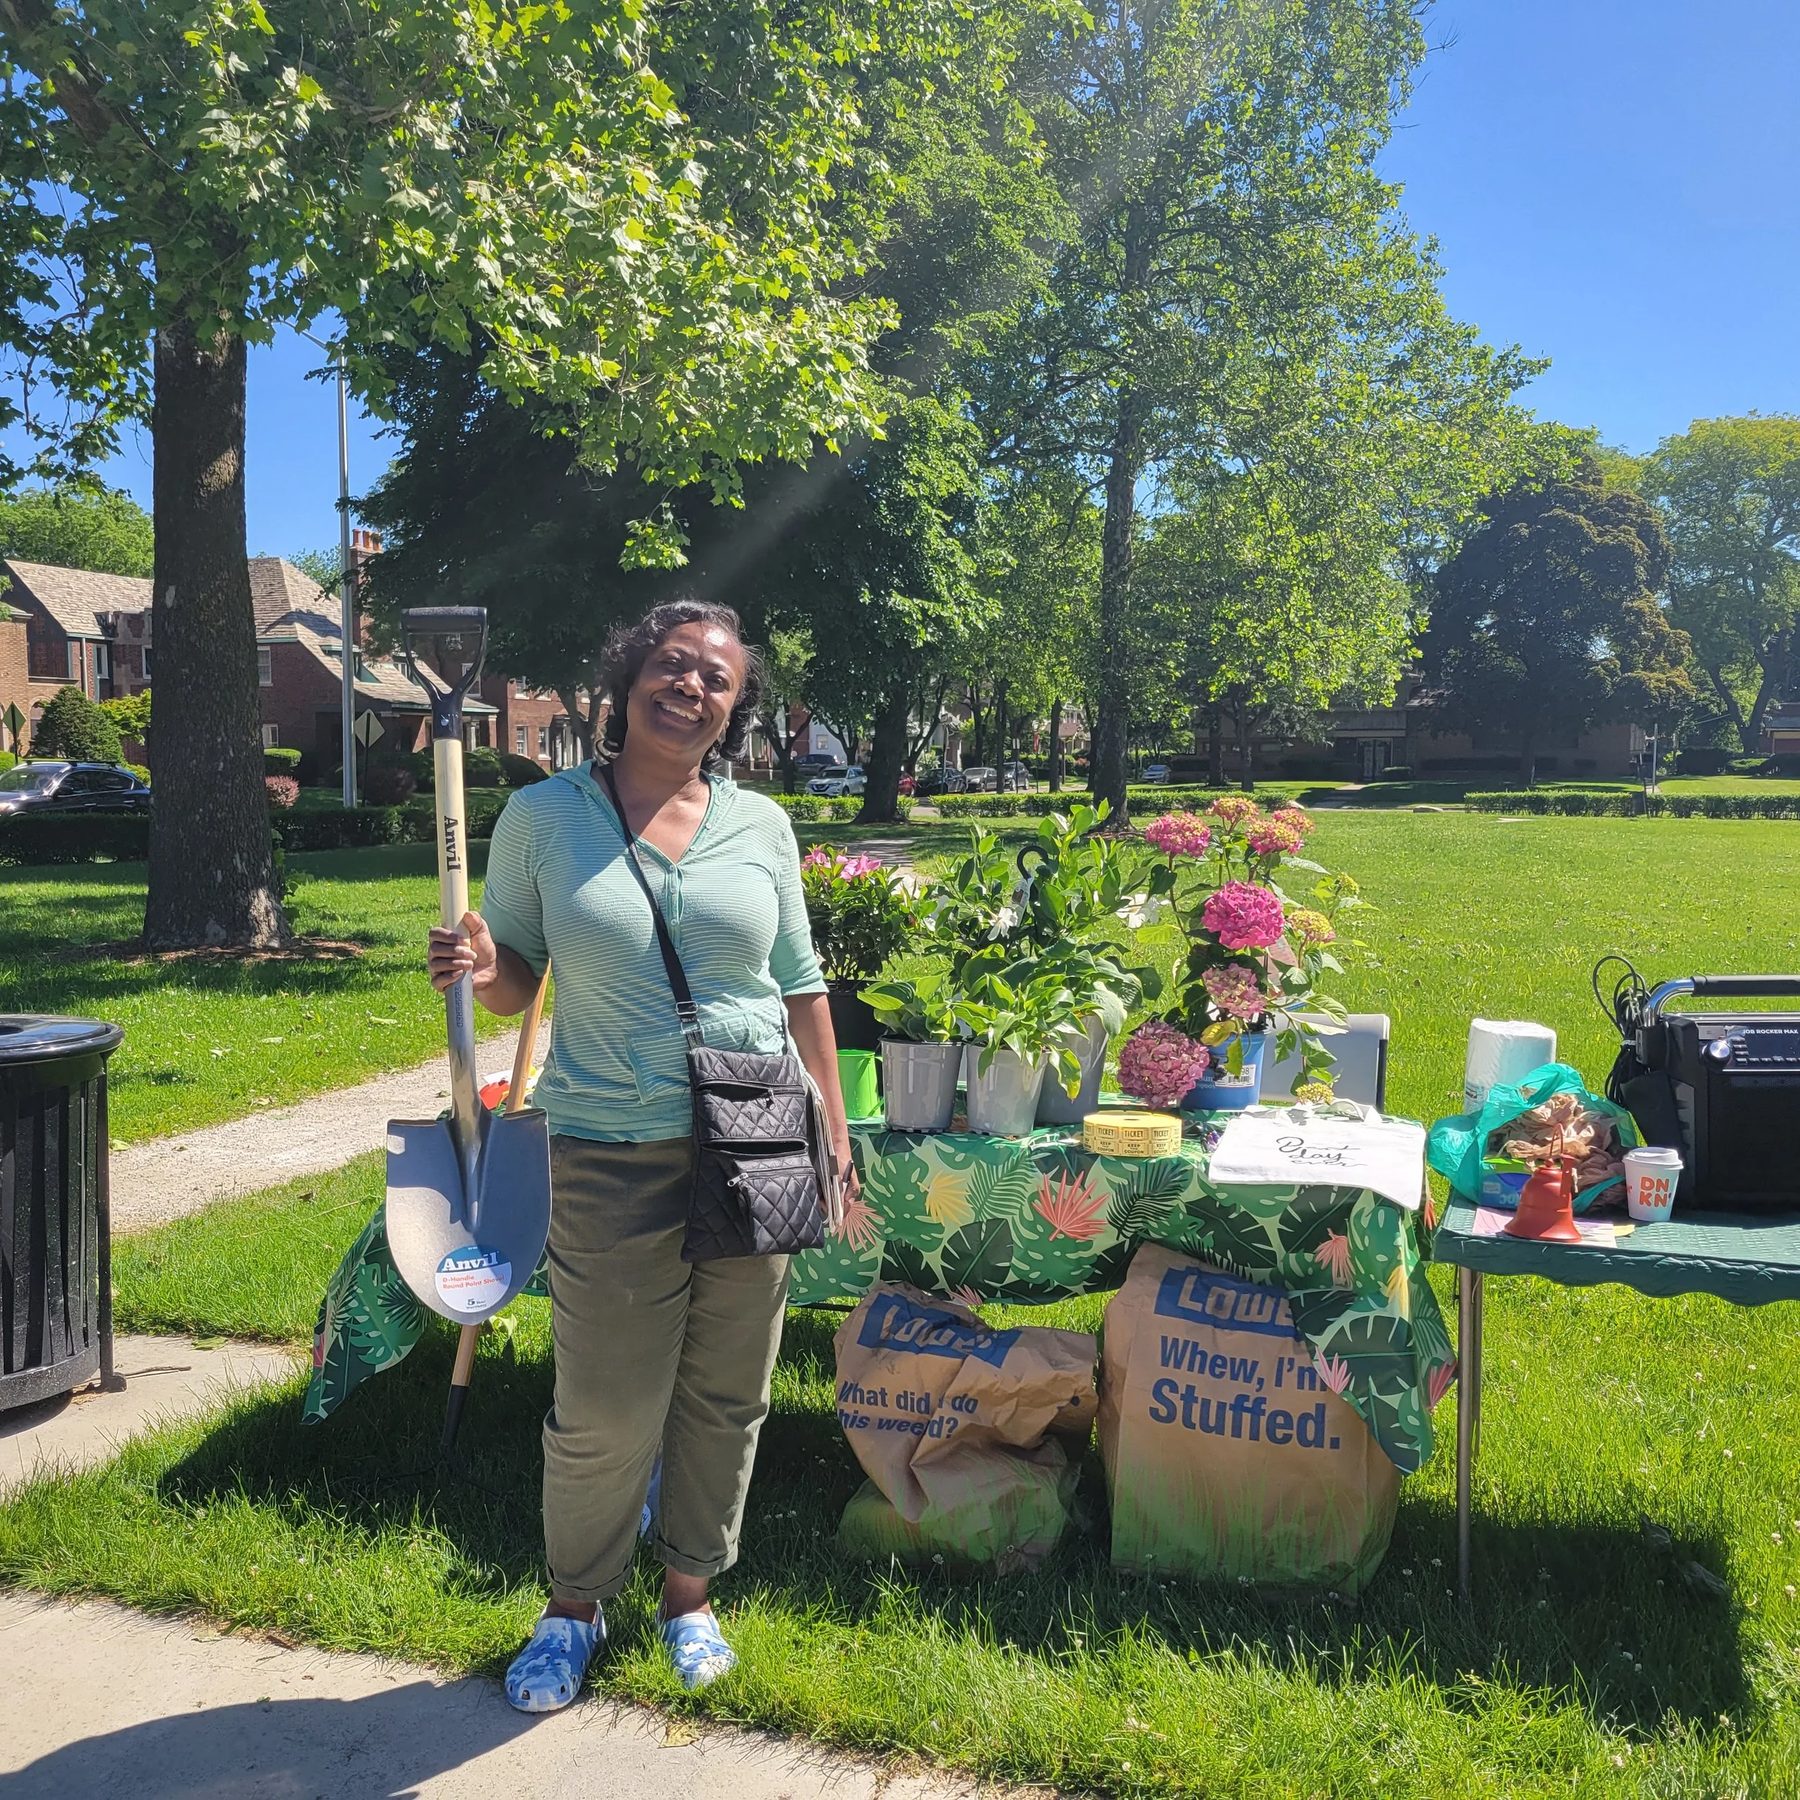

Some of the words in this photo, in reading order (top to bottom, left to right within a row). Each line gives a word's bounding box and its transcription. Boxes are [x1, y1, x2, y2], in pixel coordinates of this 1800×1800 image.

[444, 815, 462, 873] Anvil
[1098, 1127, 1114, 1137] TICKET
[1124, 1130, 1144, 1138] TICKET
[1153, 1130, 1169, 1138] TICKET
[1288, 1149, 1355, 1163] day
[1640, 1175, 1669, 1193] DN
[442, 1251, 498, 1272] Anvil
[1177, 1274, 1296, 1327] LOWE
[1160, 1335, 1265, 1392] Whew,
[838, 1380, 888, 1408] What
[895, 1390, 931, 1415] did
[951, 1393, 979, 1414] do
[838, 1408, 870, 1430] his
[1148, 1377, 1341, 1450] Stuffed.
